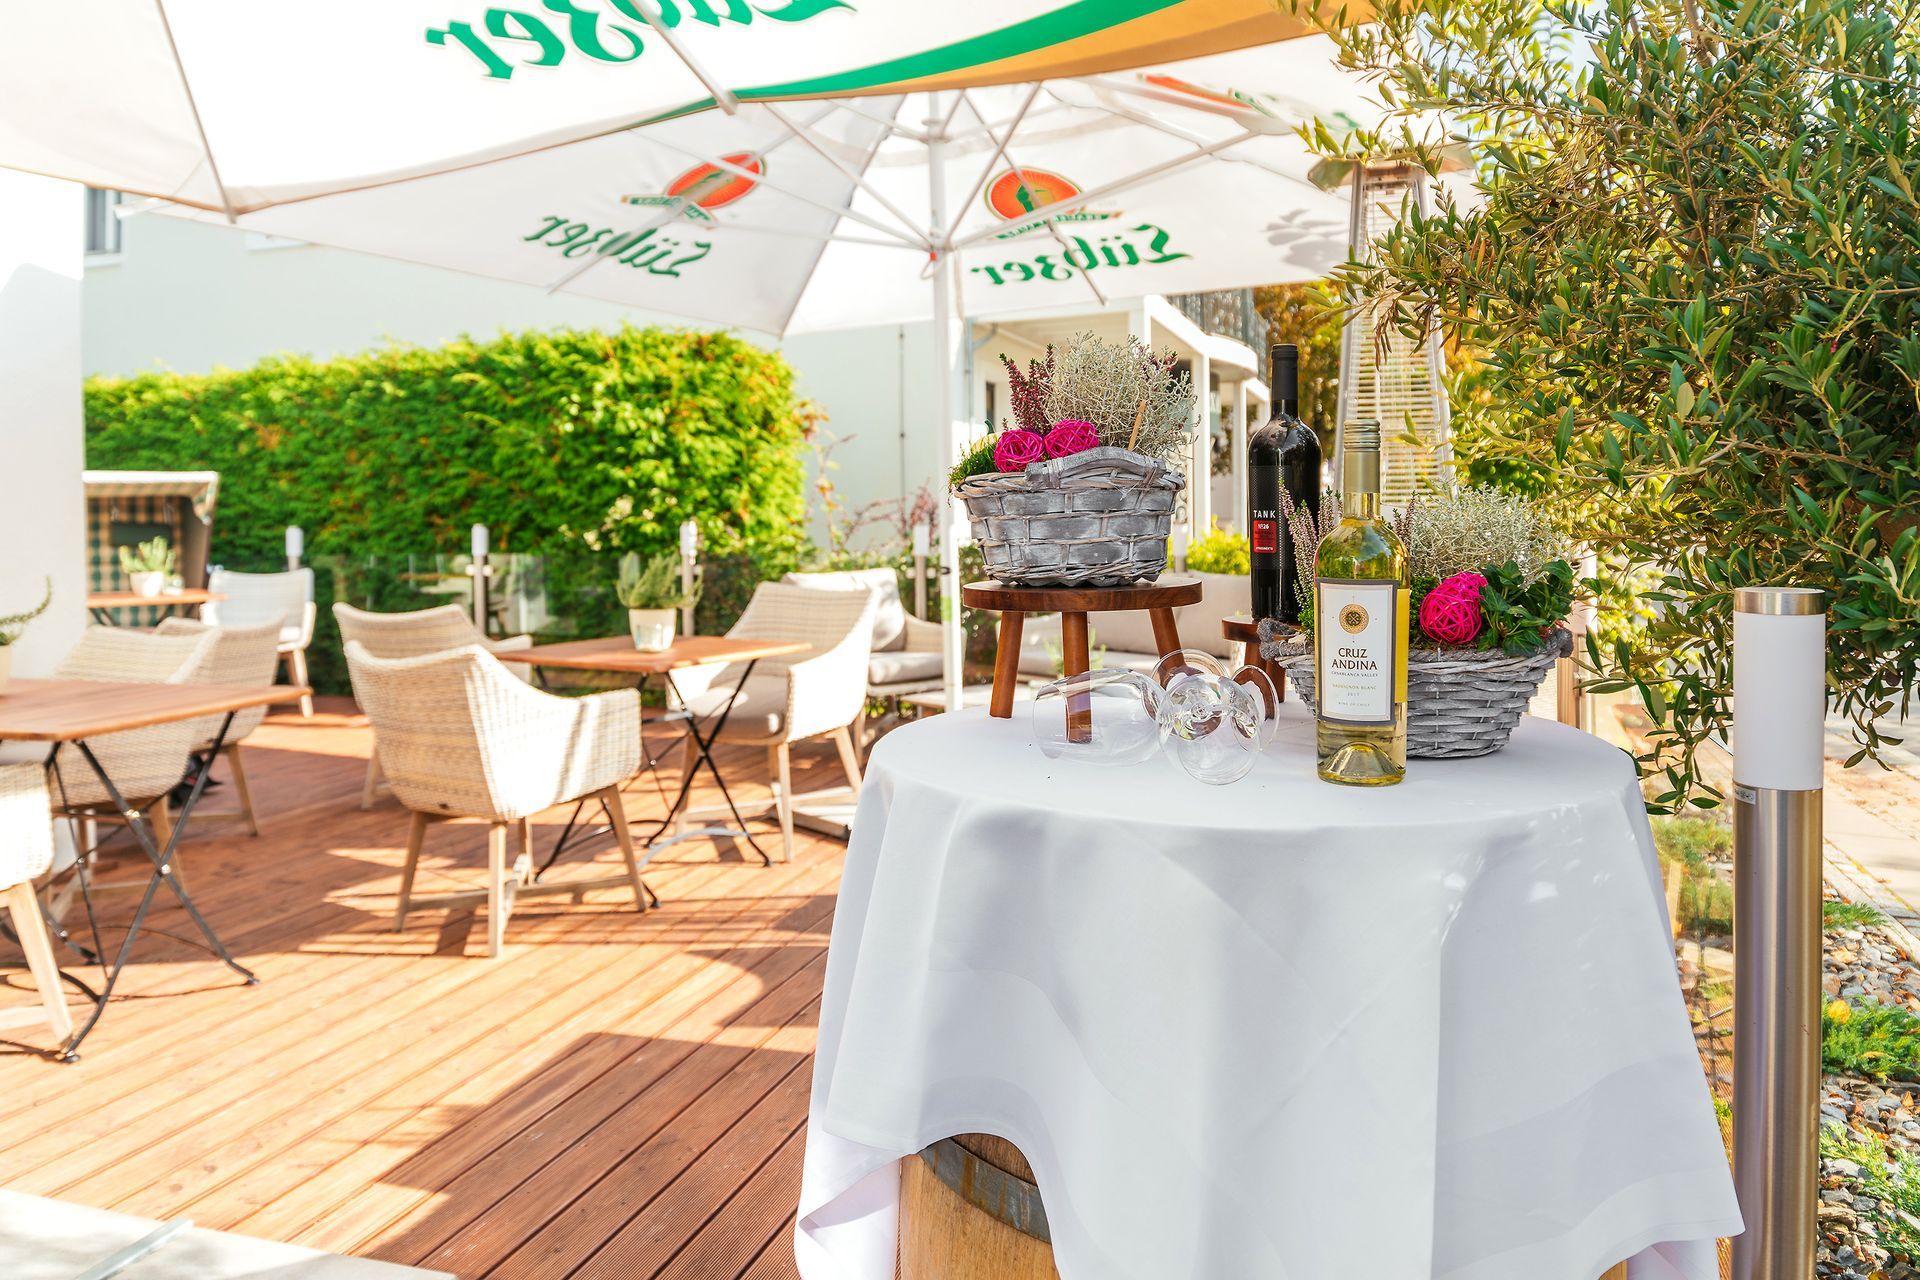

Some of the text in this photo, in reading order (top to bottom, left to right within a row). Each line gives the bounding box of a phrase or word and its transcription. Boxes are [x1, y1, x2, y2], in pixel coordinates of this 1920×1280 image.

[1253, 510, 1276, 518] TANK
[1338, 647, 1368, 659] CRUZ
[1331, 659, 1378, 670] ANDINA
